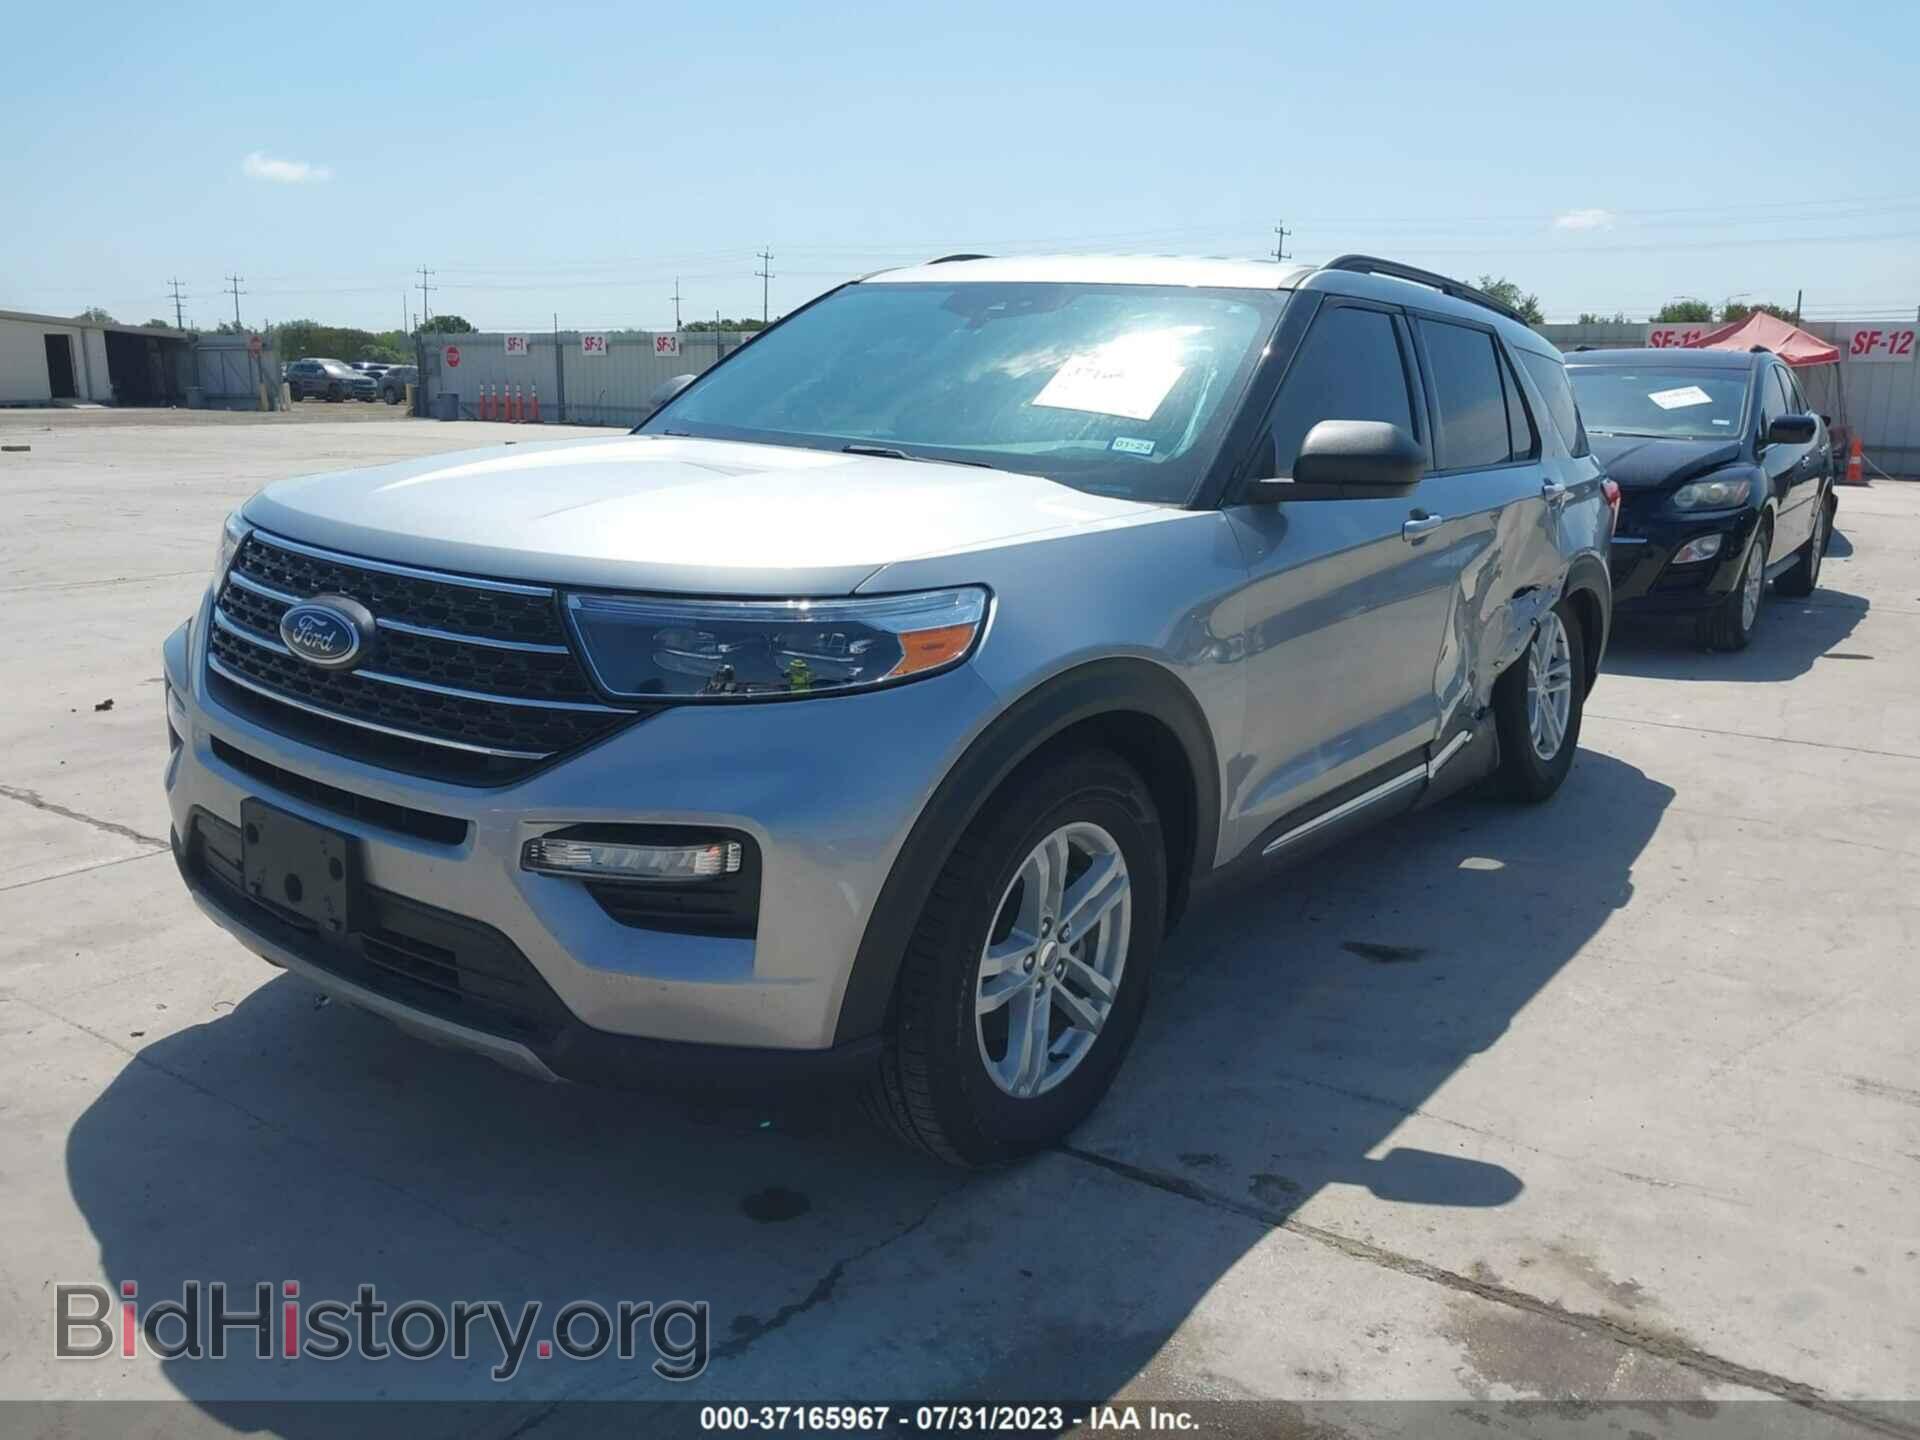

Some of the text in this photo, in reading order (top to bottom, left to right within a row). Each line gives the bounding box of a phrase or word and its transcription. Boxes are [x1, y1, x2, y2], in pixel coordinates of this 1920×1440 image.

[507, 336, 525, 351] SF-1
[584, 336, 604, 351] SF-2
[656, 336, 677, 351] SF-3
[1851, 330, 1915, 354] SF-12
[292, 615, 337, 652] Ford
